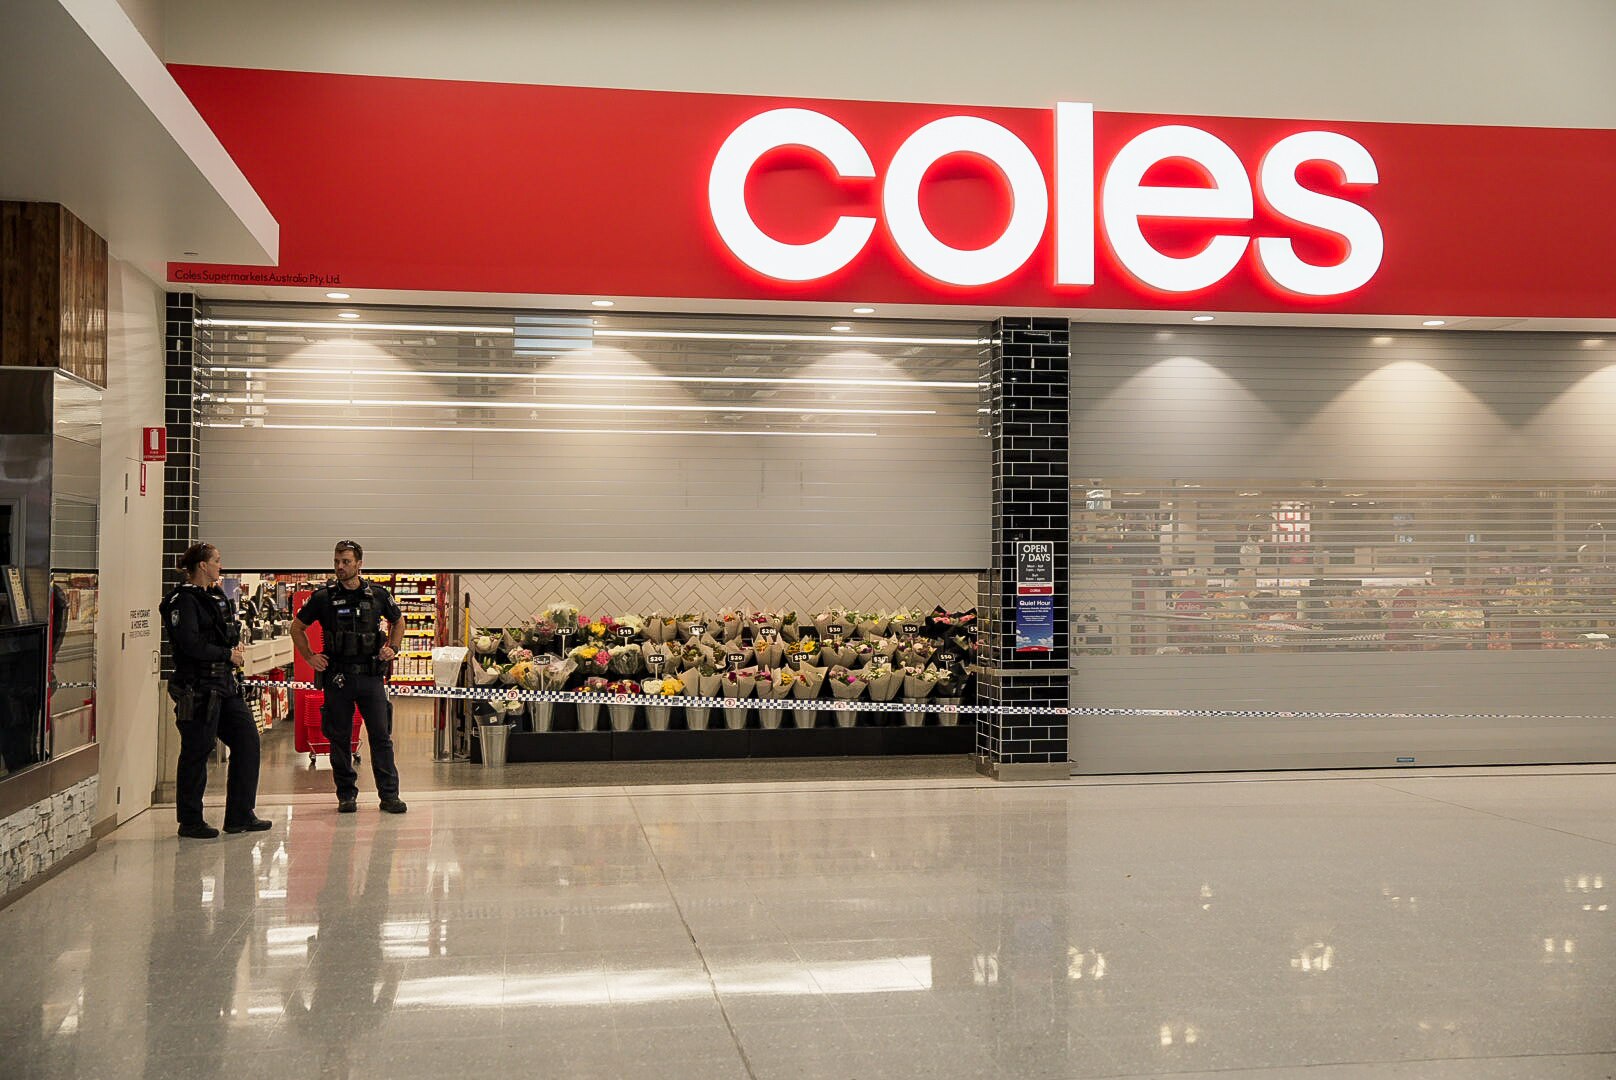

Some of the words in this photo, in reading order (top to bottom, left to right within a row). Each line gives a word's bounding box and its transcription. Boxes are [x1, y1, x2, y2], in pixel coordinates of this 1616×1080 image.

[708, 101, 1384, 296] coles
[174, 269, 202, 280] Coles
[202, 270, 269, 283] Supermarkets
[269, 272, 308, 284] Australia
[1023, 544, 1047, 553] OPEN
[1020, 553, 1026, 562] 7
[1028, 553, 1051, 562] DAYS
